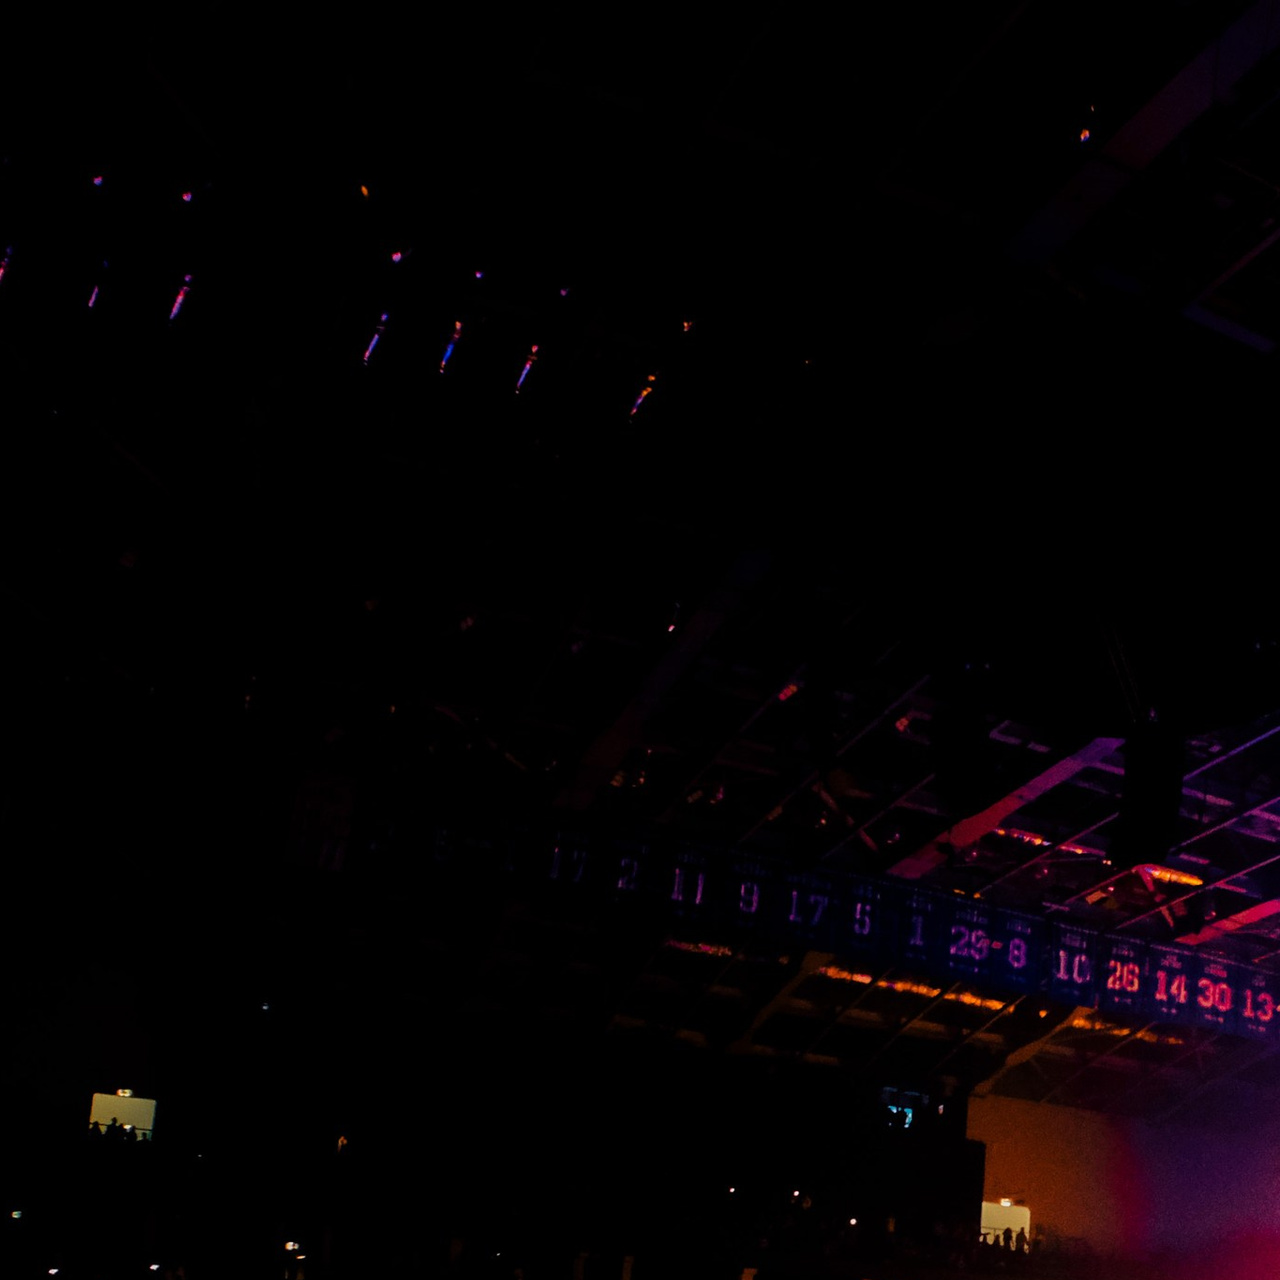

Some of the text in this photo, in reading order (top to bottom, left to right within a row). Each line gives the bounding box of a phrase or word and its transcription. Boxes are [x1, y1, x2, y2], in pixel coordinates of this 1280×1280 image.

[787, 889, 830, 926] 17
[909, 915, 925, 946] 1
[1154, 970, 1188, 1004] 14
[1197, 976, 1233, 1012] 30
